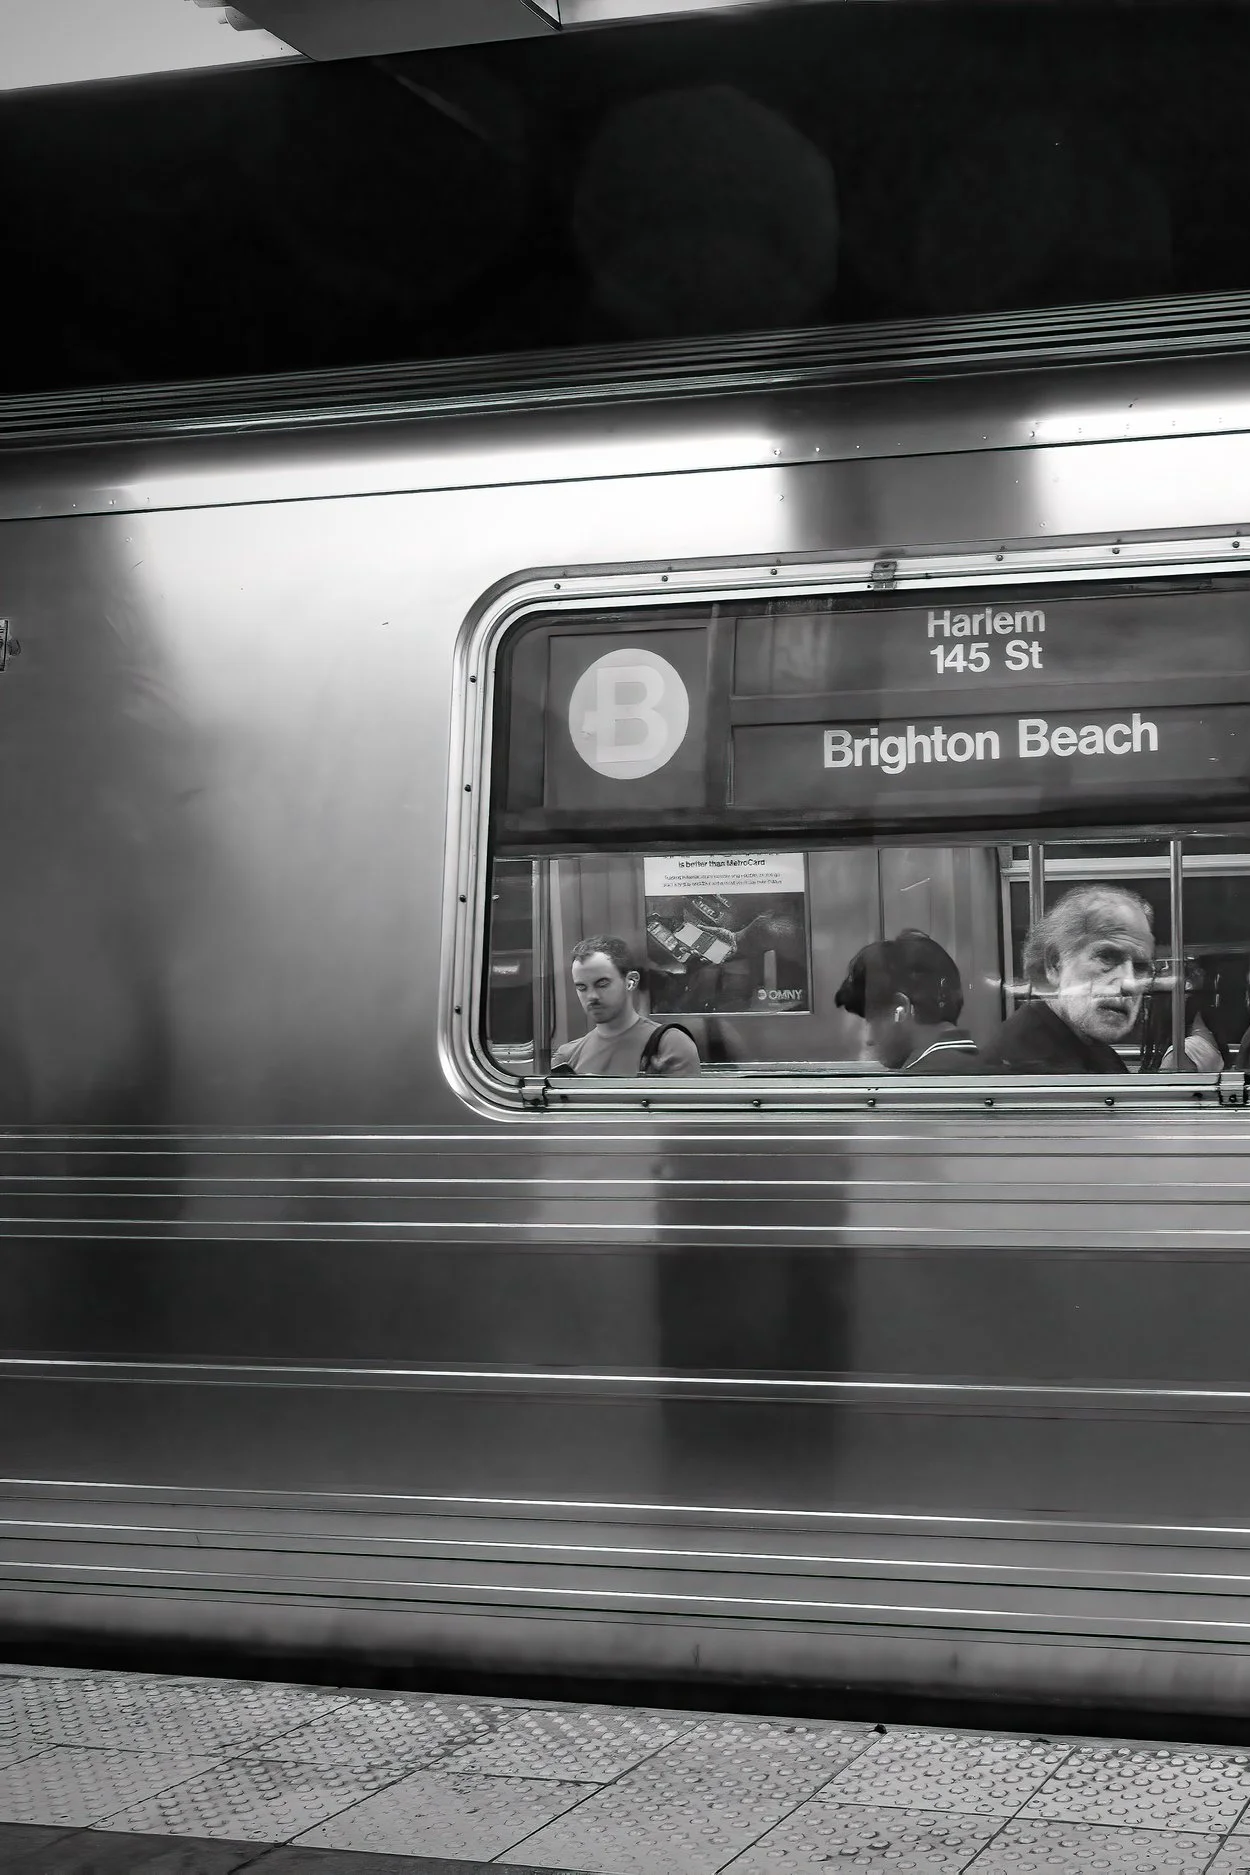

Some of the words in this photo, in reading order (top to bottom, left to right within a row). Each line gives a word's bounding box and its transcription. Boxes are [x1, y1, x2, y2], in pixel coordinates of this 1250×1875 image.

[928, 606, 1046, 638] Harlem
[930, 642, 991, 674] 145
[1005, 639, 1044, 671] St
[595, 665, 669, 763] B
[823, 725, 1000, 775] Brighton
[1018, 712, 1159, 758] Beach
[726, 858, 766, 867] MetroCard
[768, 989, 803, 1001] OMNY
